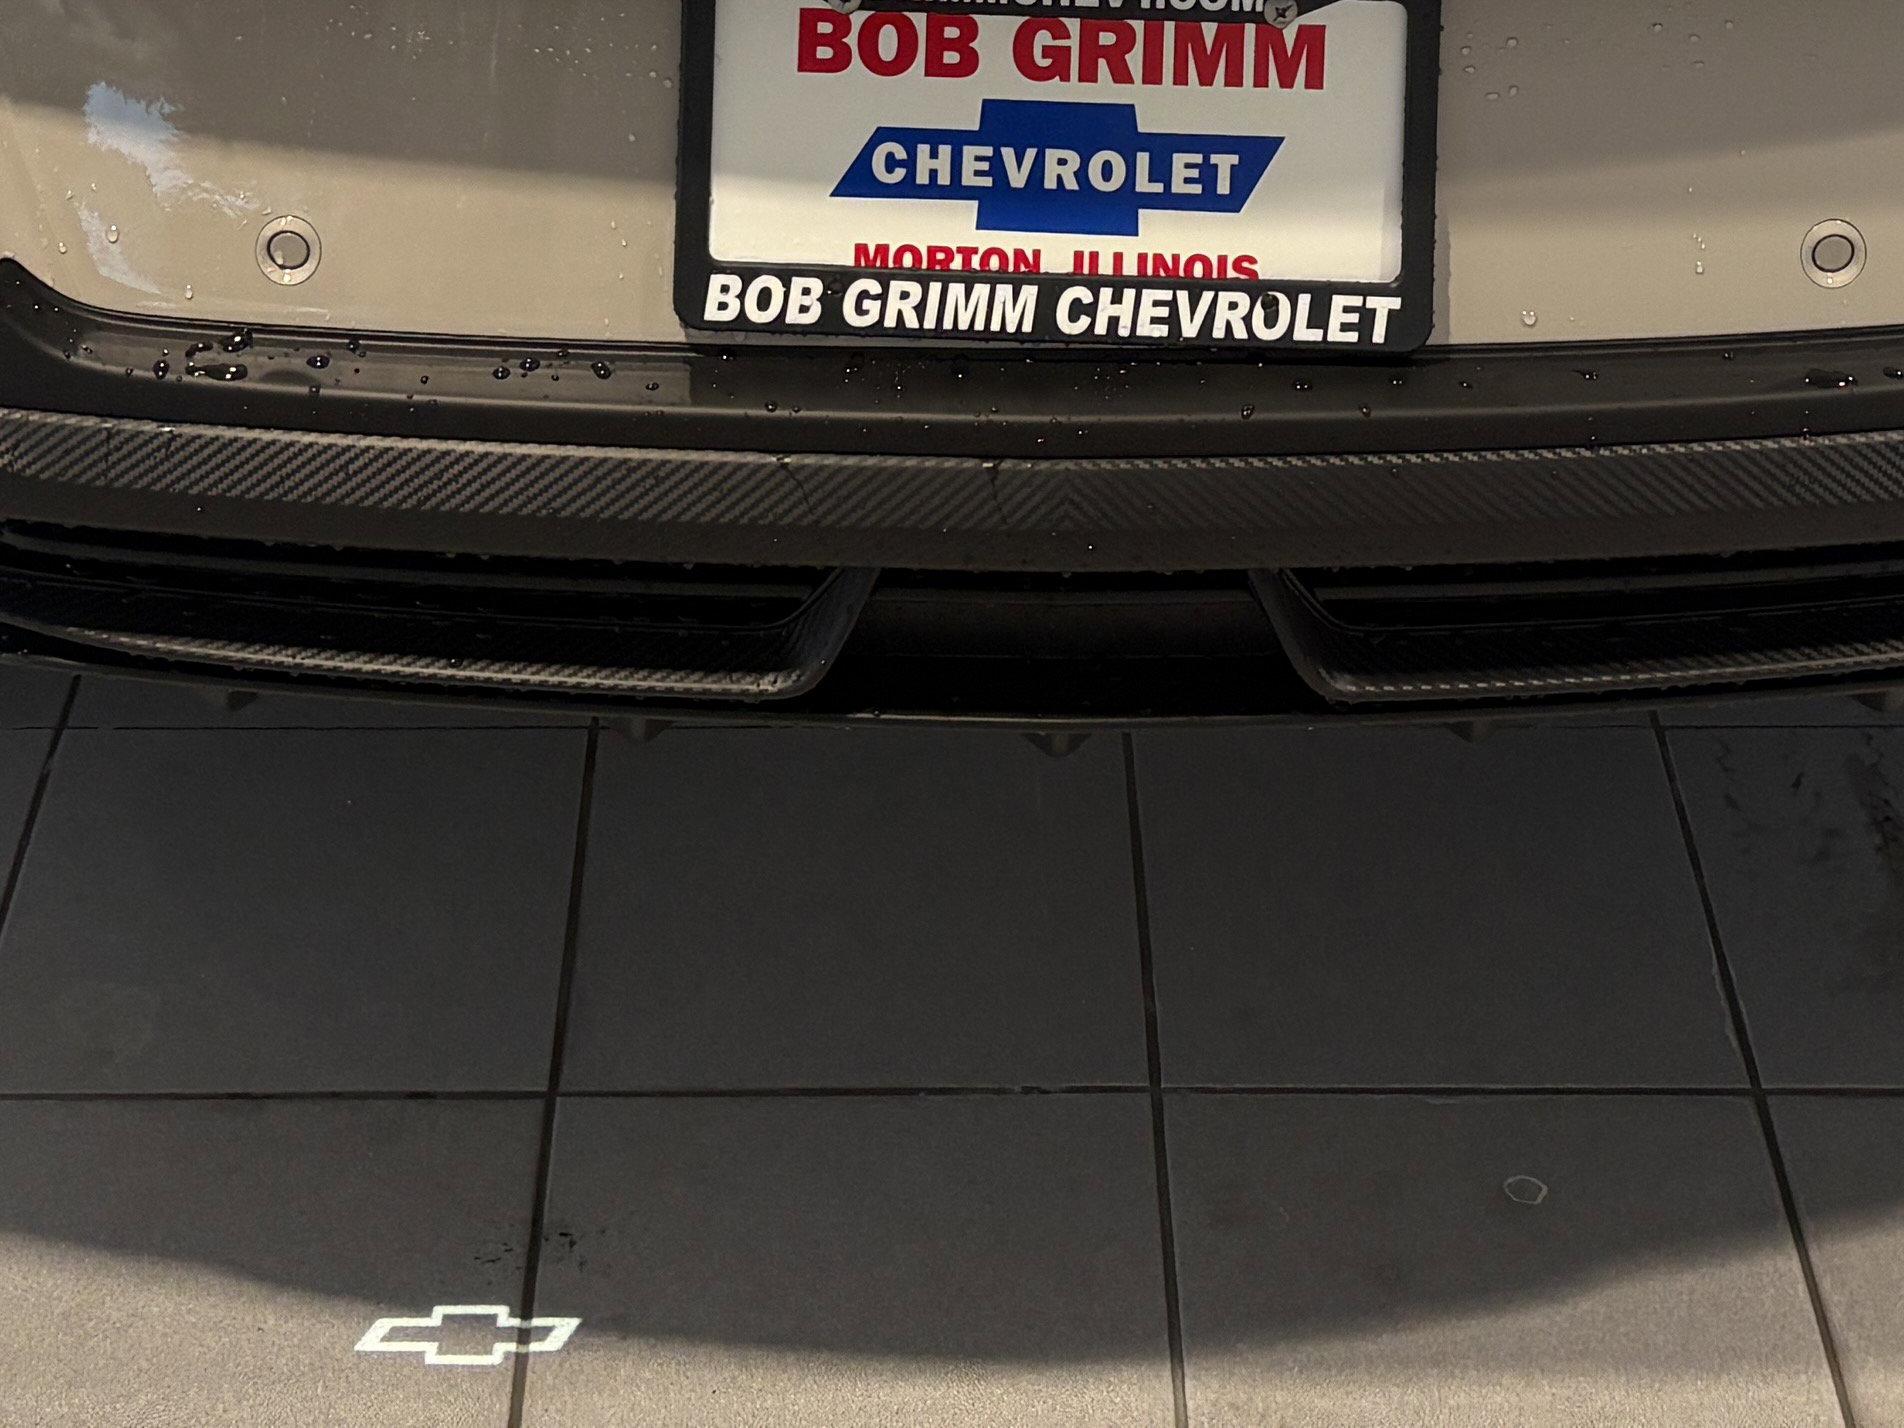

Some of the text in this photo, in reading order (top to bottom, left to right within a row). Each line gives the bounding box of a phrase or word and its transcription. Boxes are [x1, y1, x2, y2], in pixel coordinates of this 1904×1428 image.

[796, 7, 1327, 91] BOB GRIMM
[871, 142, 1241, 196] CHEVROLET
[703, 274, 1402, 345] BOB GRIMM CHEVROLET
